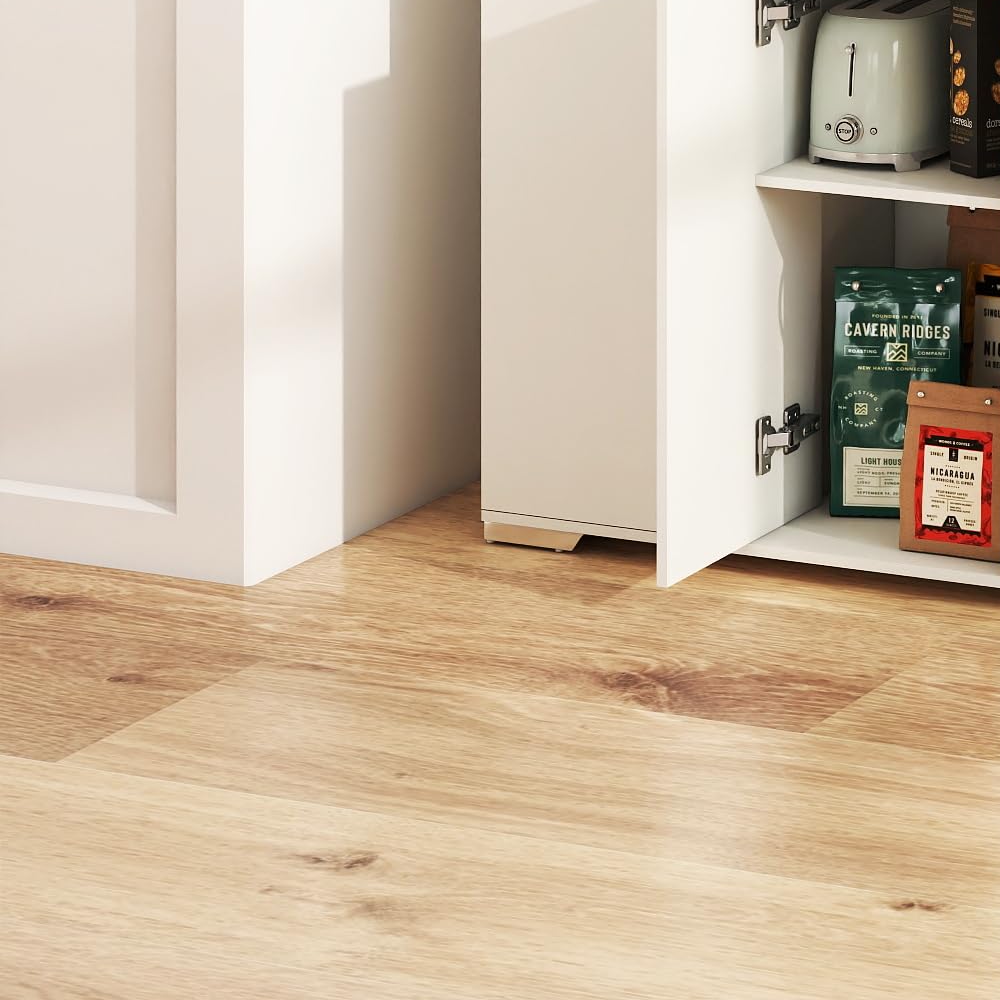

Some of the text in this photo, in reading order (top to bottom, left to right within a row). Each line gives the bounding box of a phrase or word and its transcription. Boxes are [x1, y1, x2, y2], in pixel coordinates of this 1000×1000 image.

[844, 322, 951, 339] CAVERN RIDGES
[861, 457, 902, 466] LIGHT HOUS
[930, 467, 975, 480] NICARAGUA
